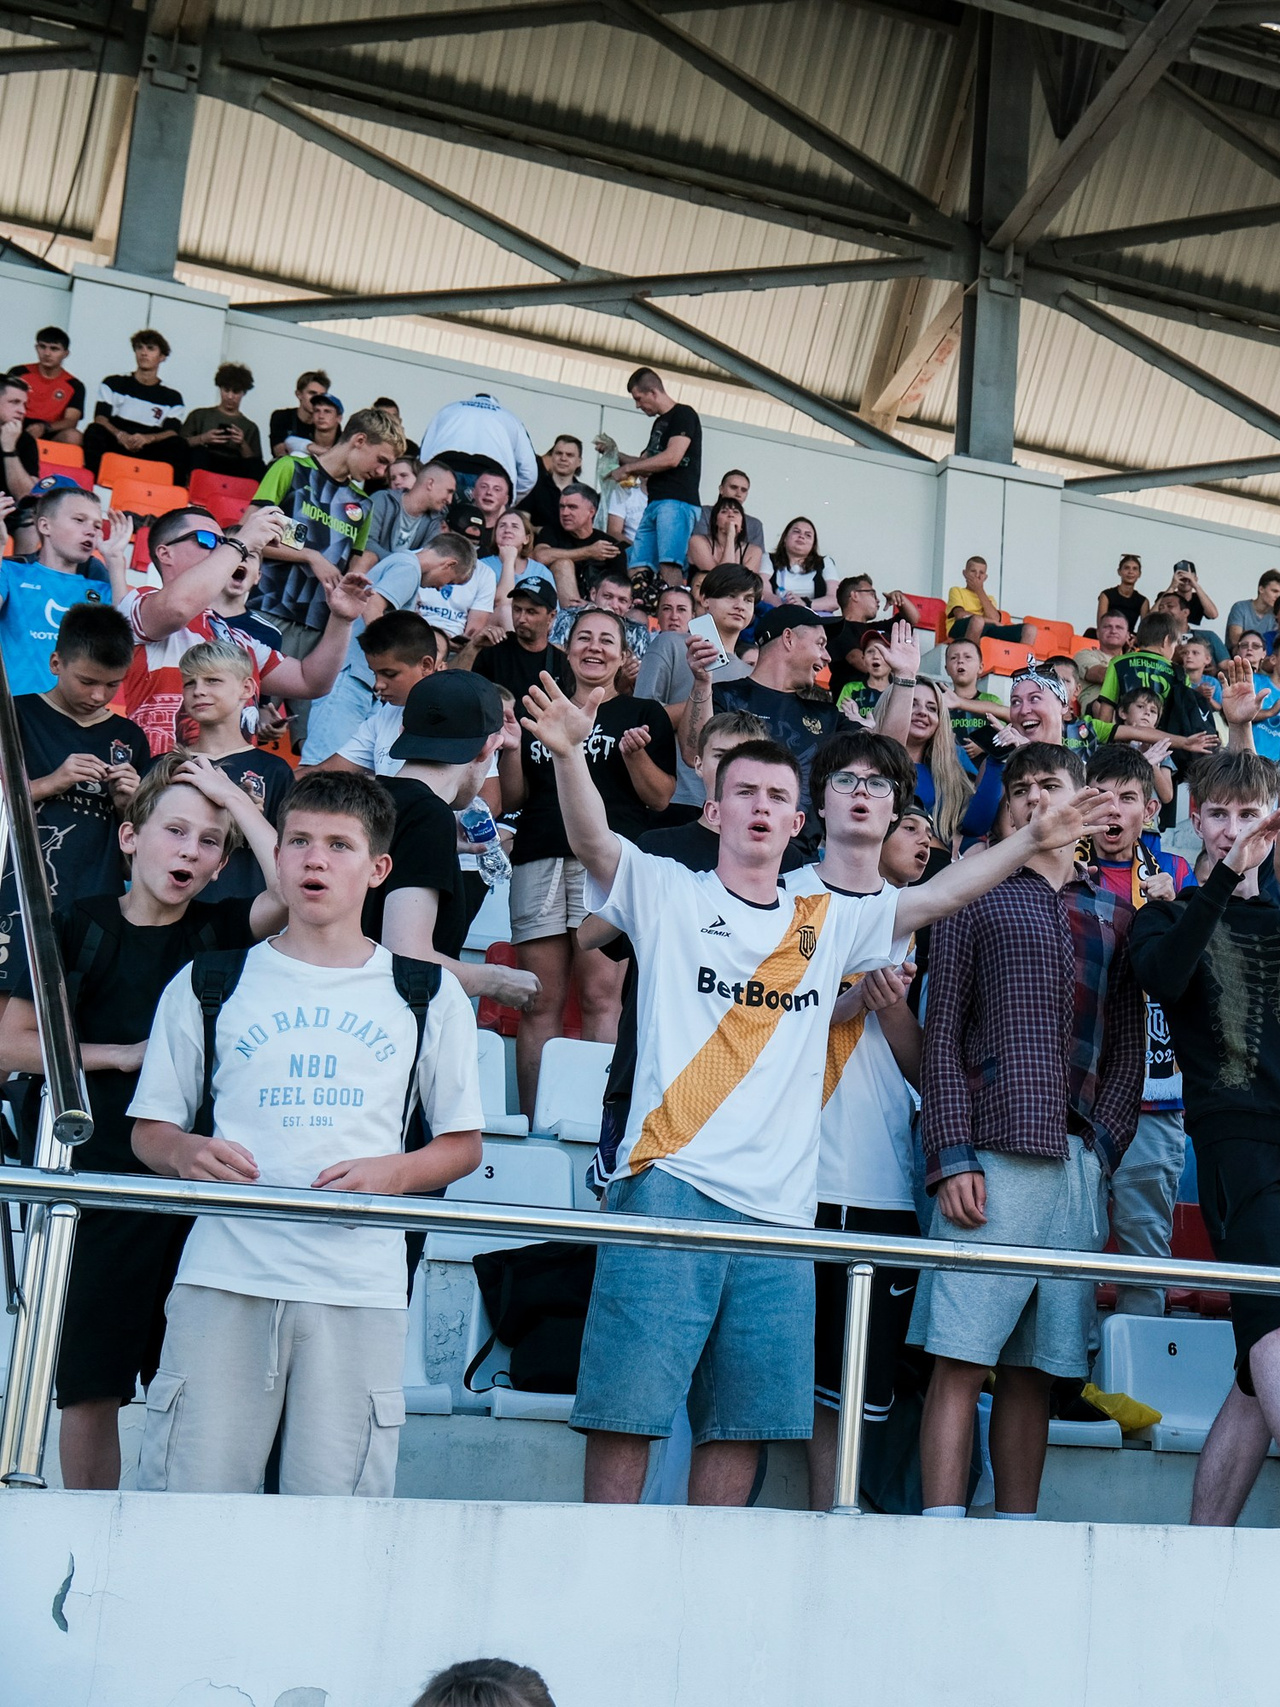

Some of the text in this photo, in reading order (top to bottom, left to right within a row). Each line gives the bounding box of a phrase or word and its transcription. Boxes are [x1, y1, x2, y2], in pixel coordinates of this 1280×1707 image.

[700, 928, 732, 939] DEMIX
[697, 966, 819, 1012] BetBoom
[235, 1006, 397, 1063] NO BAD DAYS
[289, 1053, 337, 1079] NBD
[258, 1086, 364, 1108] FEEL GOOD
[282, 1115, 334, 1128] EST. 1991
[484, 1165, 495, 1179] 3
[1167, 1341, 1178, 1357] 6
